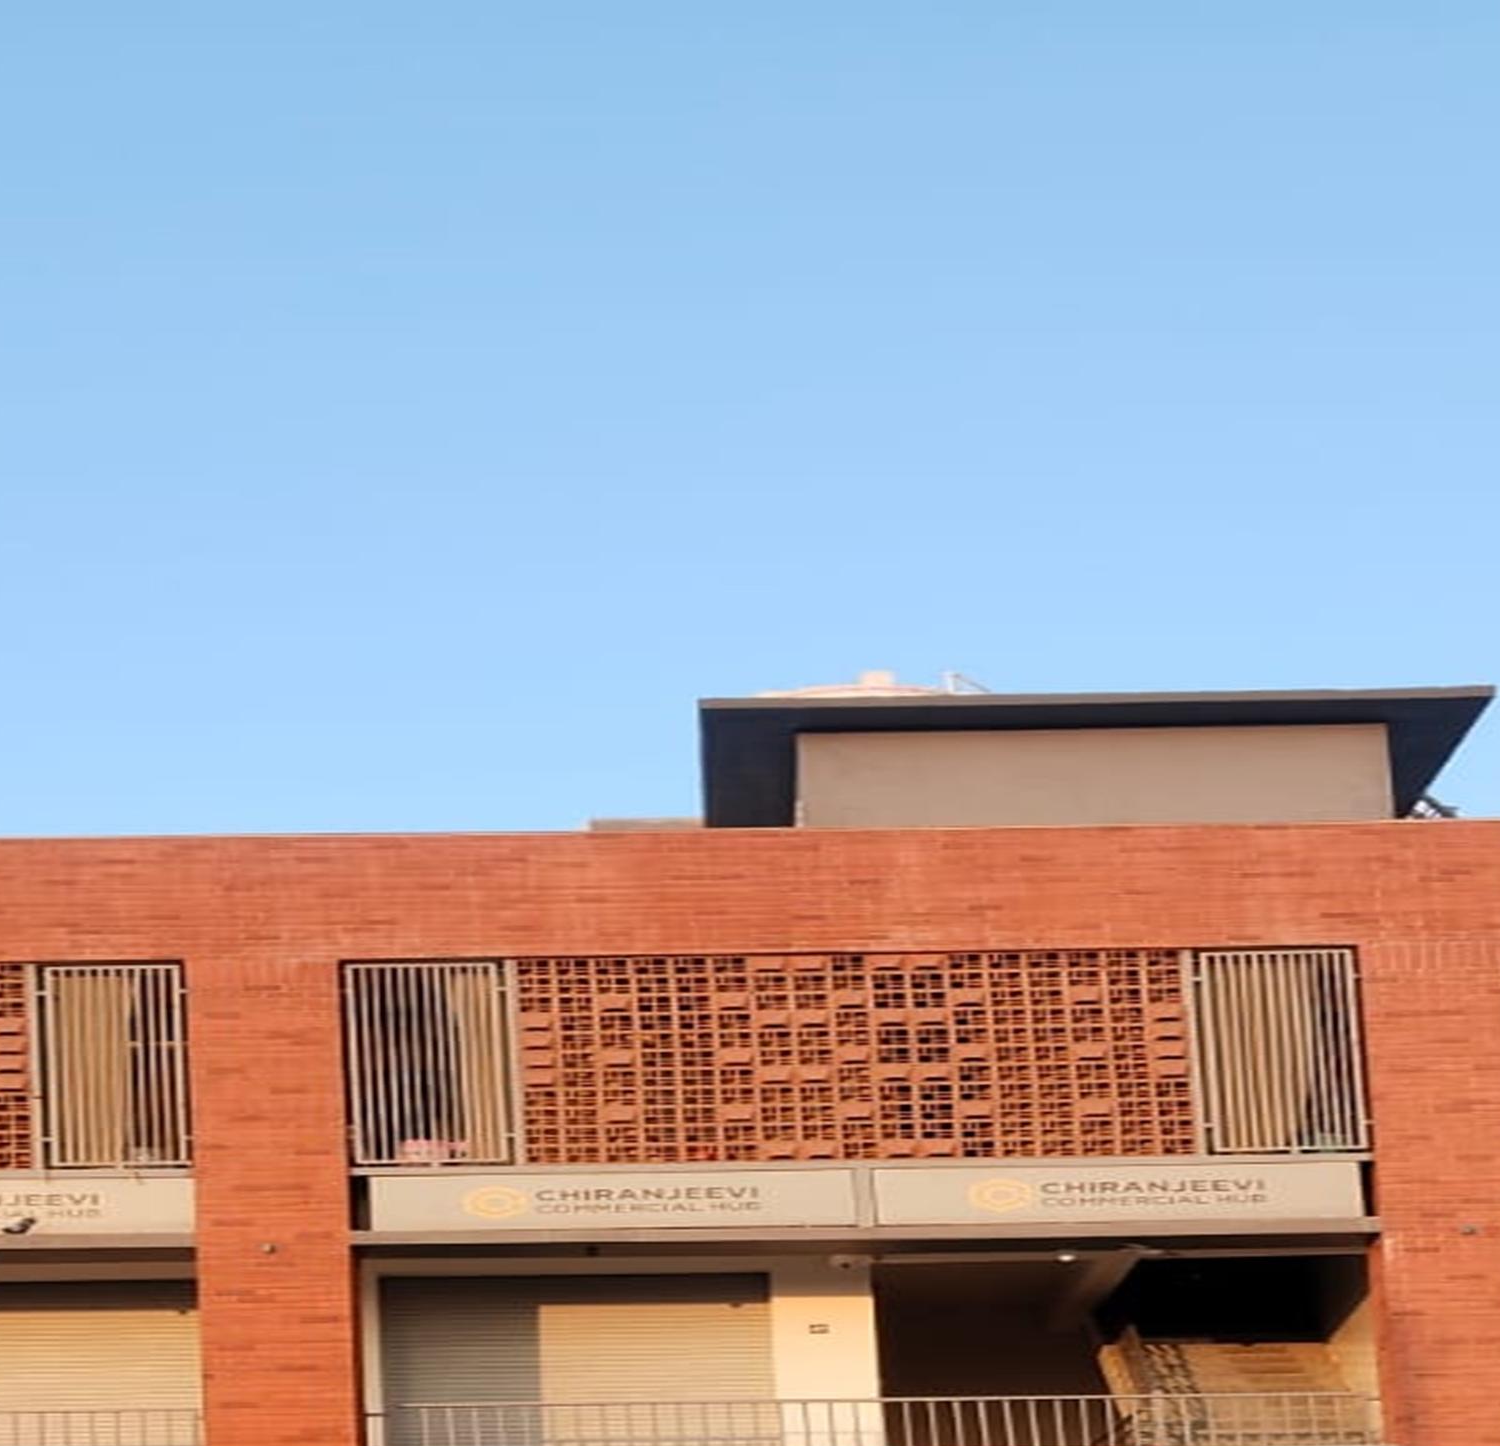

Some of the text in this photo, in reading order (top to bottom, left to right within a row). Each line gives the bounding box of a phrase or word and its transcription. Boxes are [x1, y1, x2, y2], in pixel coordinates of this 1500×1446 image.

[1040, 1179, 1266, 1195] CHIRANJEEVI
[535, 1186, 760, 1202] CHIRANJEEVI
[1215, 1193, 1267, 1204] HUB
[710, 1201, 762, 1212] HUB
